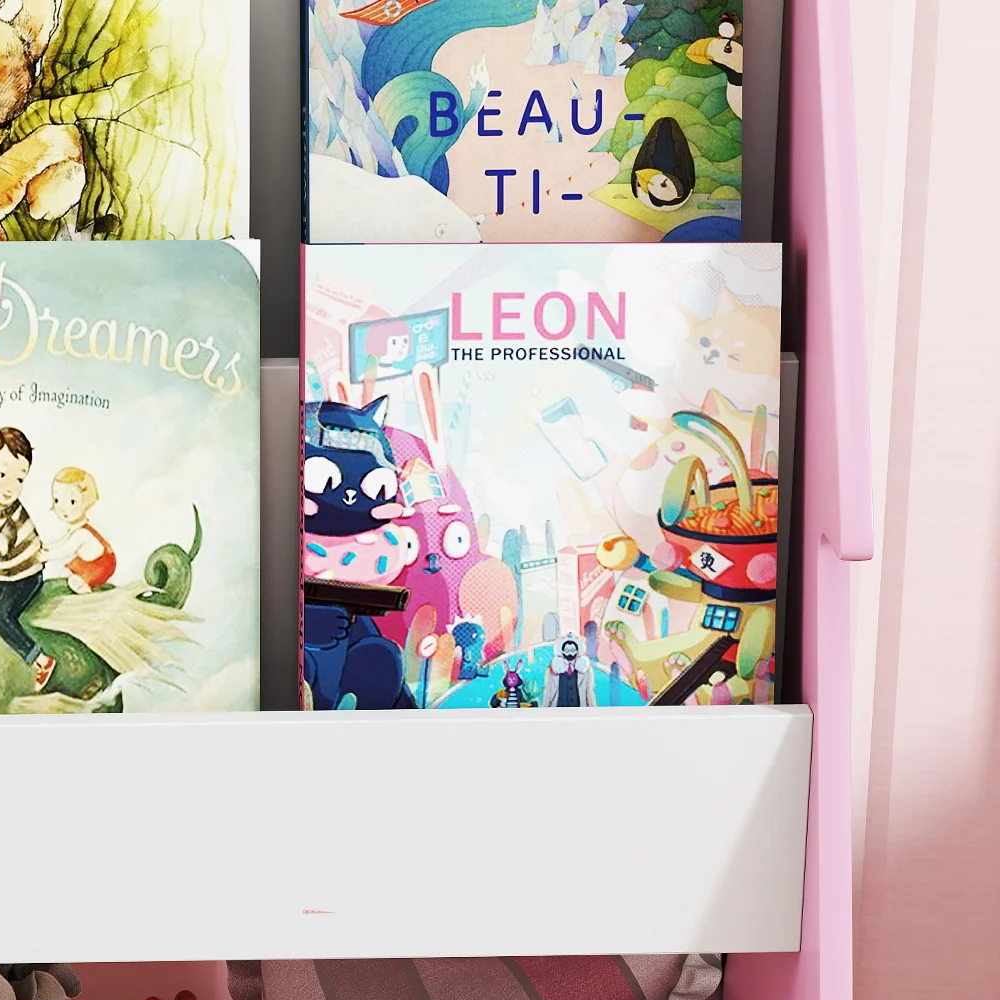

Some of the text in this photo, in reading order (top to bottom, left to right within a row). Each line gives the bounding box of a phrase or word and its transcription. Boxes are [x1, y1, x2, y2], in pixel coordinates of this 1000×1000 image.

[451, 291, 626, 341] LEON
[451, 347, 626, 361] THE PROFESSIONAL
[9, 384, 26, 402] of
[29, 381, 111, 410] Imagination
